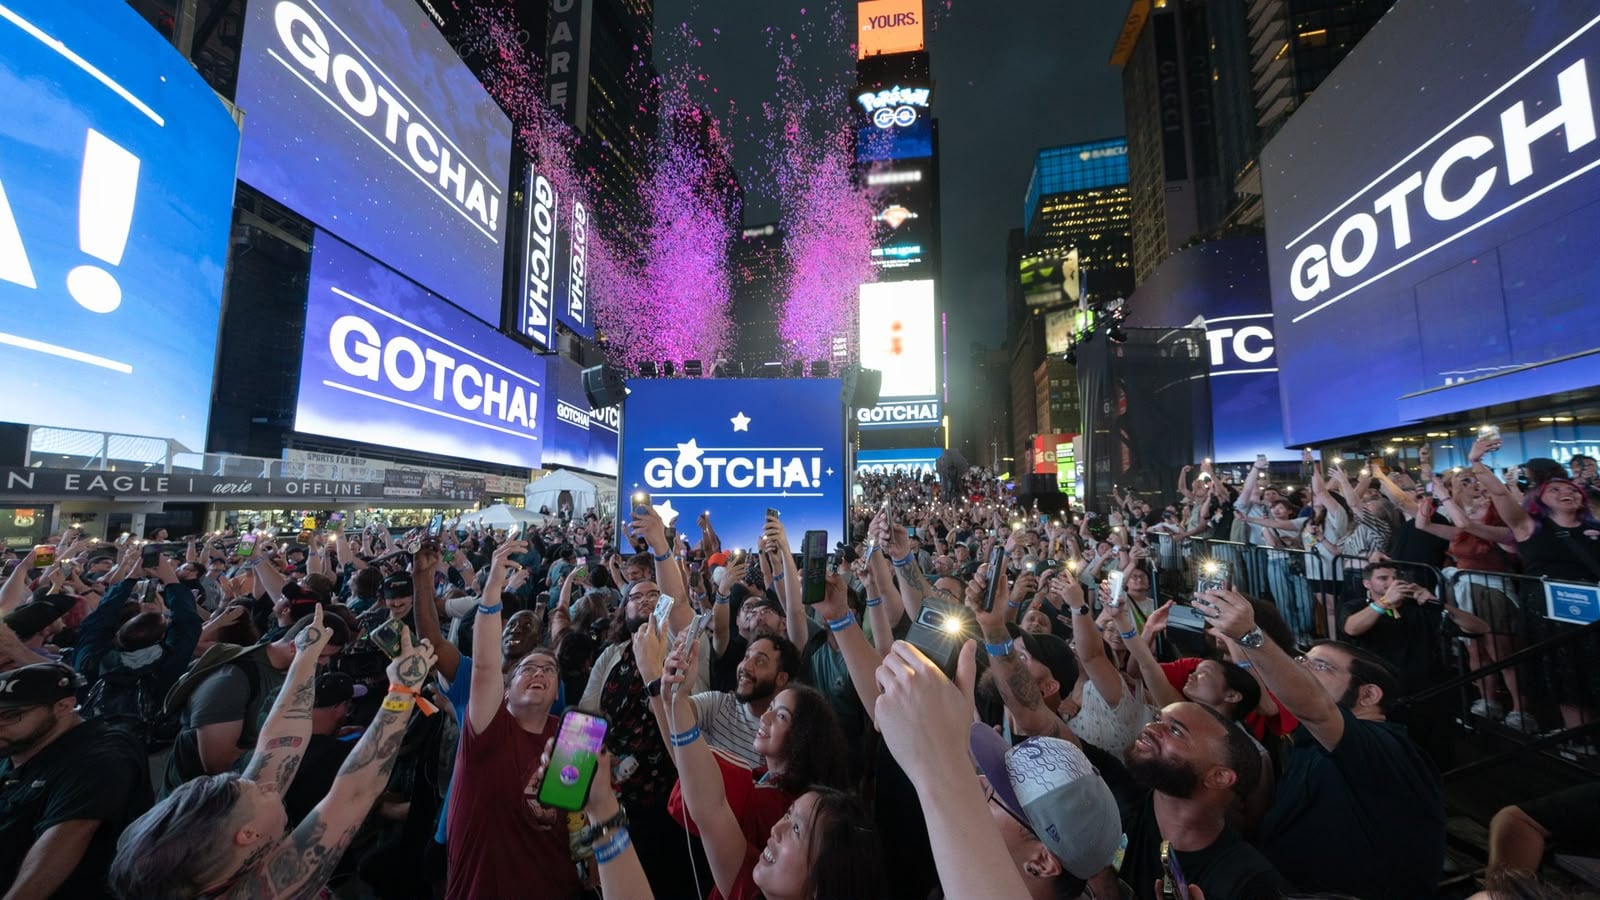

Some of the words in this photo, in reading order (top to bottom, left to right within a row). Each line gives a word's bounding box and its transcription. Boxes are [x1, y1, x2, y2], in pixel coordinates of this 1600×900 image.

[868, 12, 919, 30] YOURS.
[275, 0, 499, 232] GOTCHA!
[873, 105, 917, 129] GO
[1291, 58, 1596, 302] GOTCH
[527, 175, 553, 344] GOTCHA!
[570, 202, 587, 329] GOTCHA!
[329, 315, 538, 429] GOTCHA!
[557, 403, 589, 427] GOTCHA!
[857, 403, 938, 422] GOTCHA!
[307, 452, 335, 463] SPORTS
[7, 471, 35, 489] N
[65, 474, 169, 492] EAGLE
[212, 479, 253, 496] aerie
[644, 457, 821, 488] GOTCHA!
